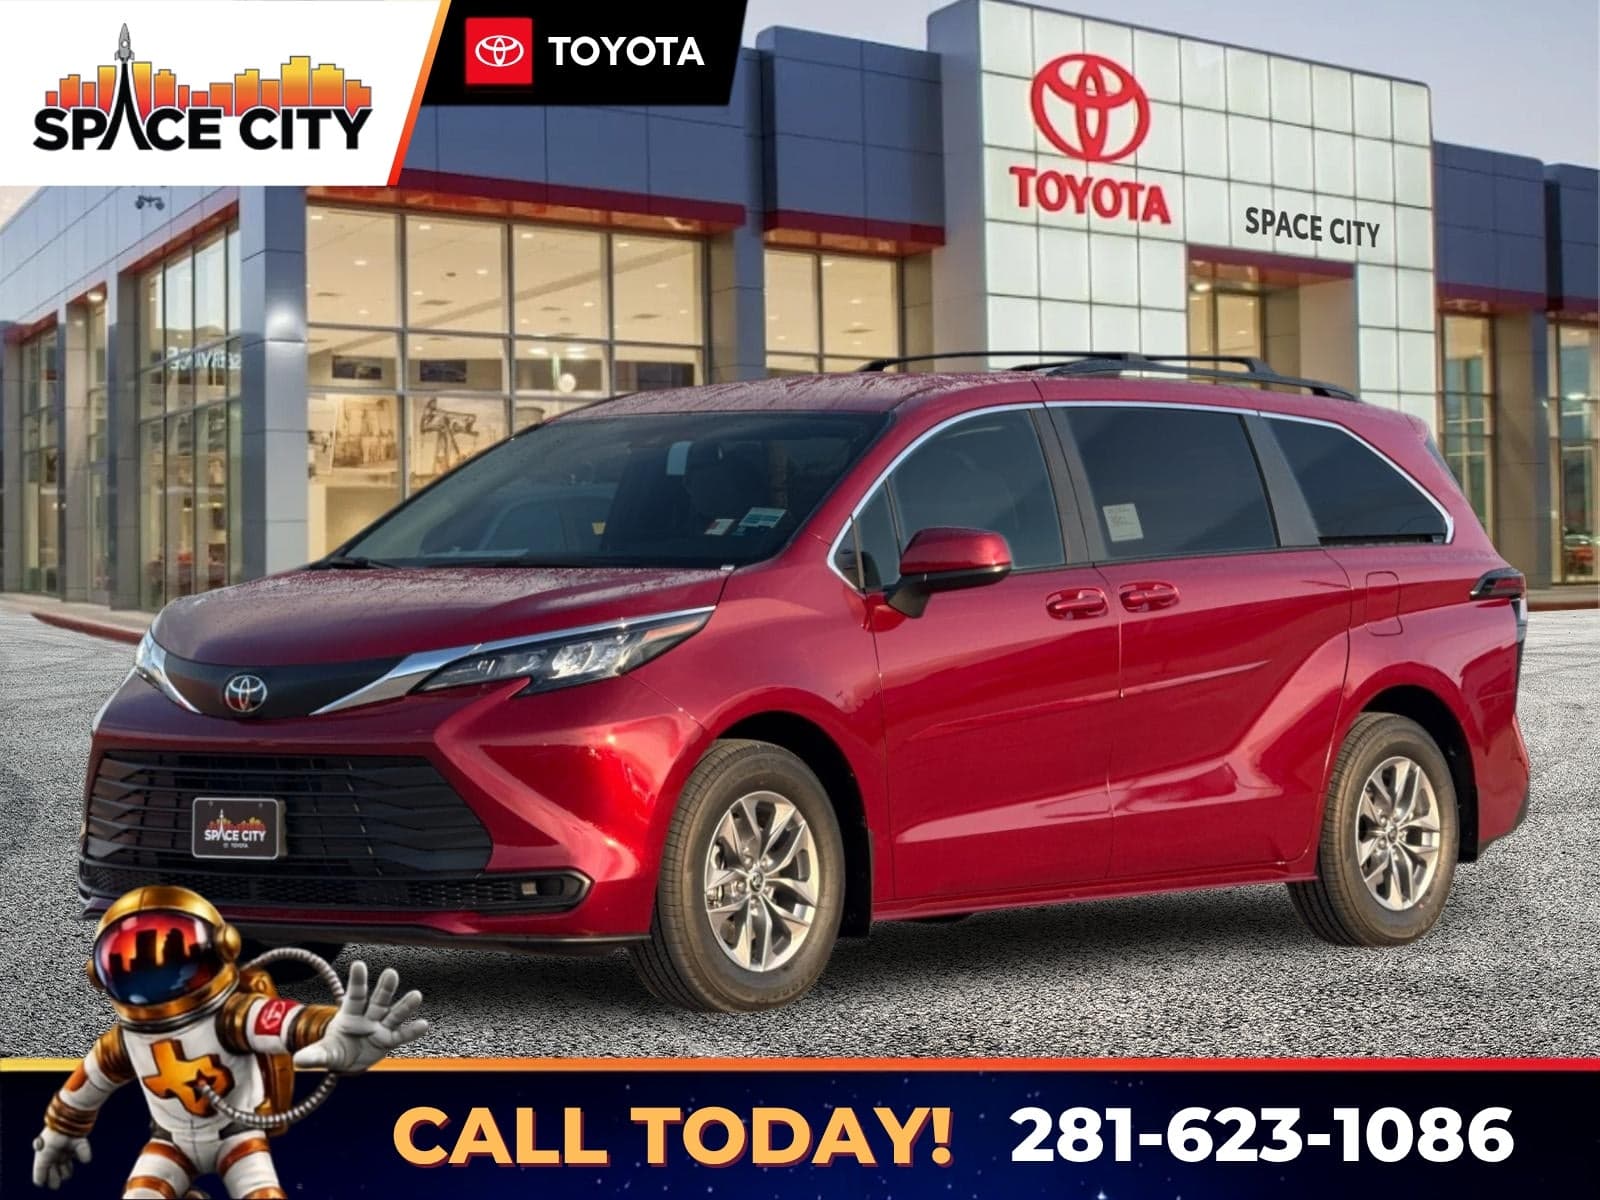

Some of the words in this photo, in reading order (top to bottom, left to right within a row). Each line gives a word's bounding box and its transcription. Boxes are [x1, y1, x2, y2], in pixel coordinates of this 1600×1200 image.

[1009, 166, 1172, 224] TOYOTA
[1245, 207, 1322, 241] SPACE
[1329, 218, 1380, 248] CITY
[204, 829, 239, 841] SPACE
[241, 830, 266, 842] CITY
